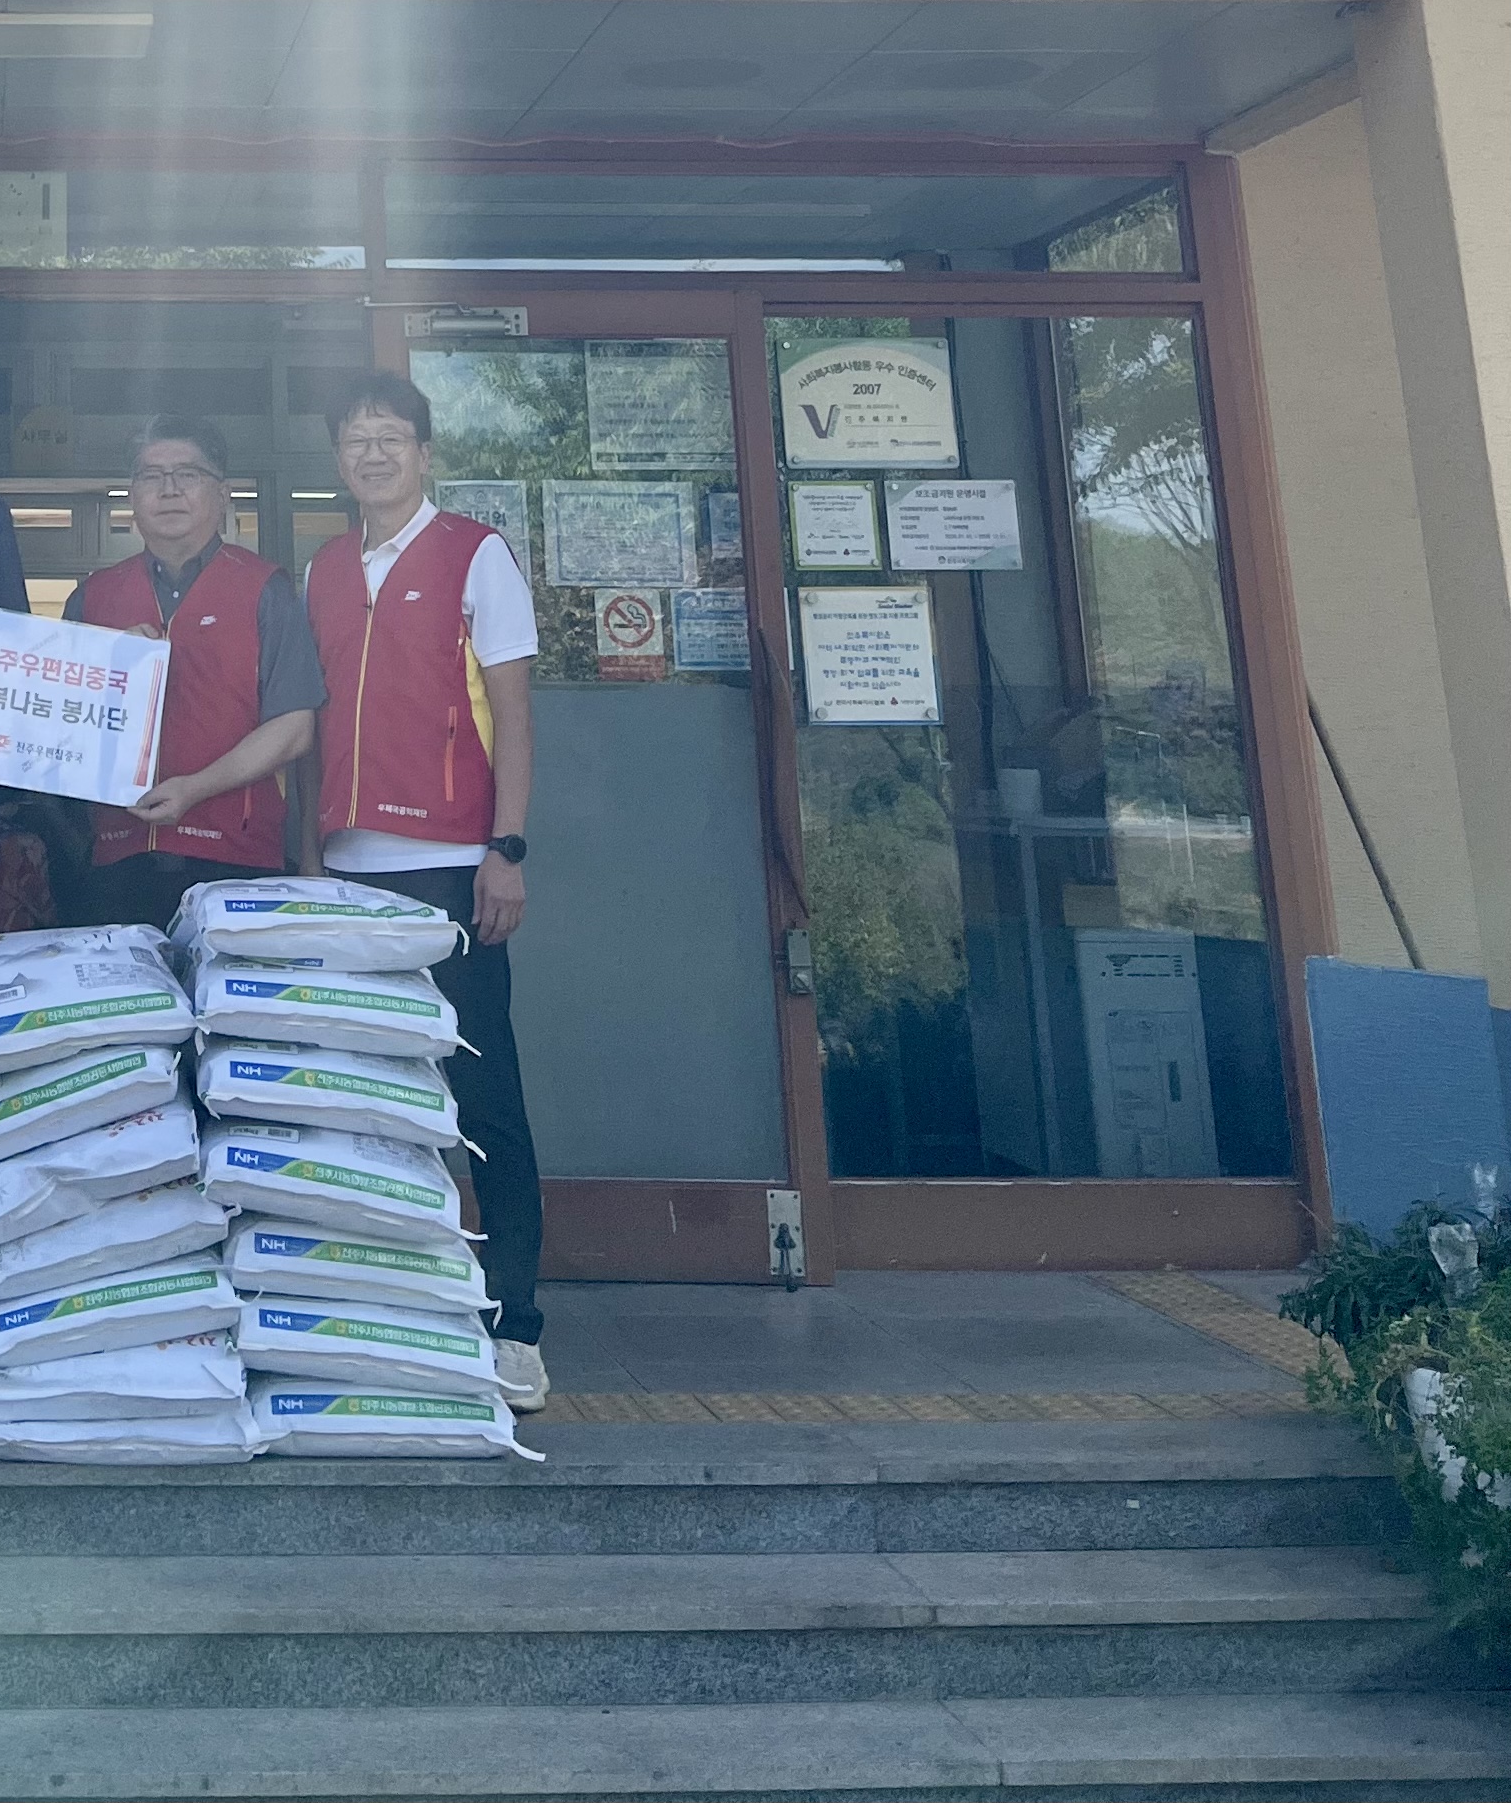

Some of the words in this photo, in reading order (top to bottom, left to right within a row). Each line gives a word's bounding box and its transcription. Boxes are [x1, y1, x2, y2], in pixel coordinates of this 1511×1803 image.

[875, 360, 895, 374] 우수
[852, 384, 882, 396] 2007
[61, 698, 129, 732] 봉사단
[16, 741, 84, 765] 진주우편집중국
[232, 902, 256, 910] NH
[232, 982, 258, 994] NH
[236, 1064, 262, 1076] NH
[234, 1151, 259, 1165] NH
[260, 1237, 287, 1251] NH
[5, 1311, 30, 1326] NH
[266, 1312, 292, 1326] NH
[278, 1398, 304, 1411] NH
